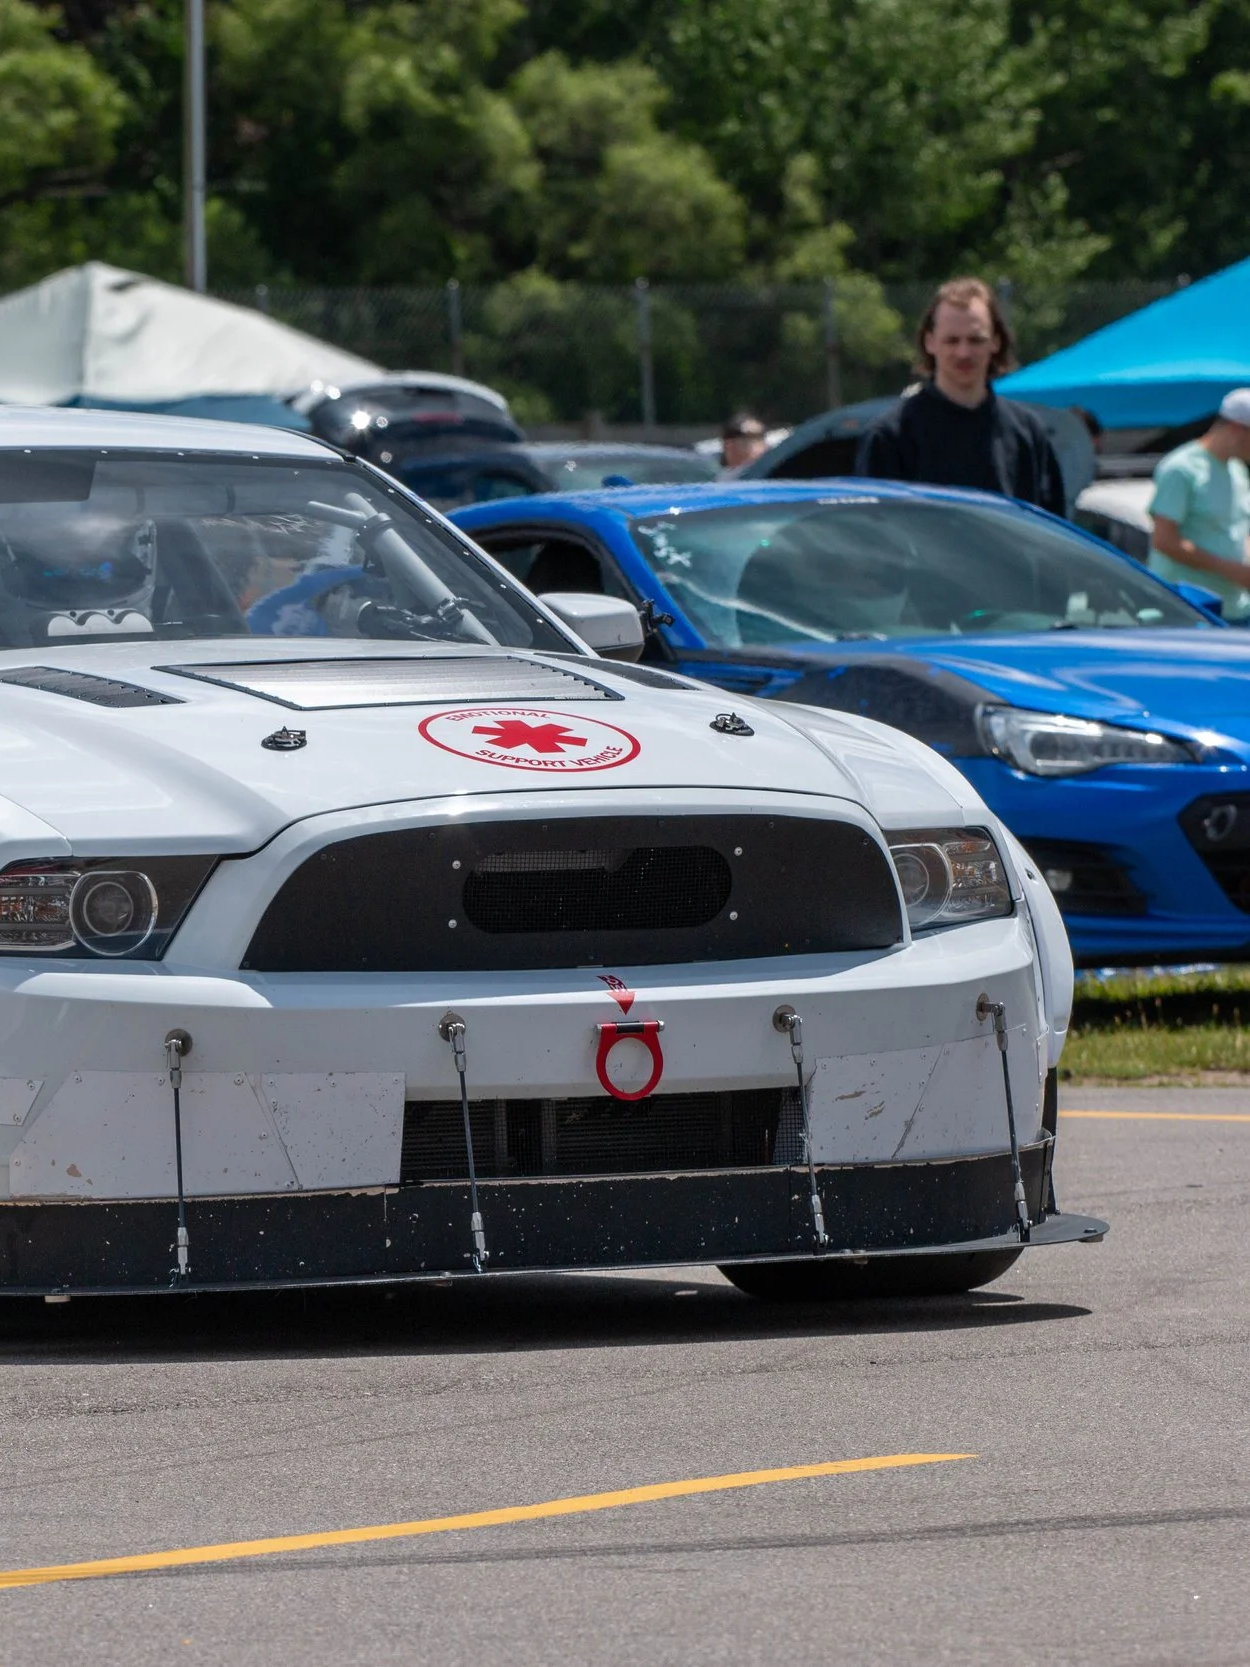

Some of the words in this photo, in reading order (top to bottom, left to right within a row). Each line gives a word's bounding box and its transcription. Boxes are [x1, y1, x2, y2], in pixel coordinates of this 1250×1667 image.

[445, 710, 551, 722] EMOTIONAL
[475, 749, 567, 768] SUPPORT
[569, 745, 623, 768] VEHICLE
